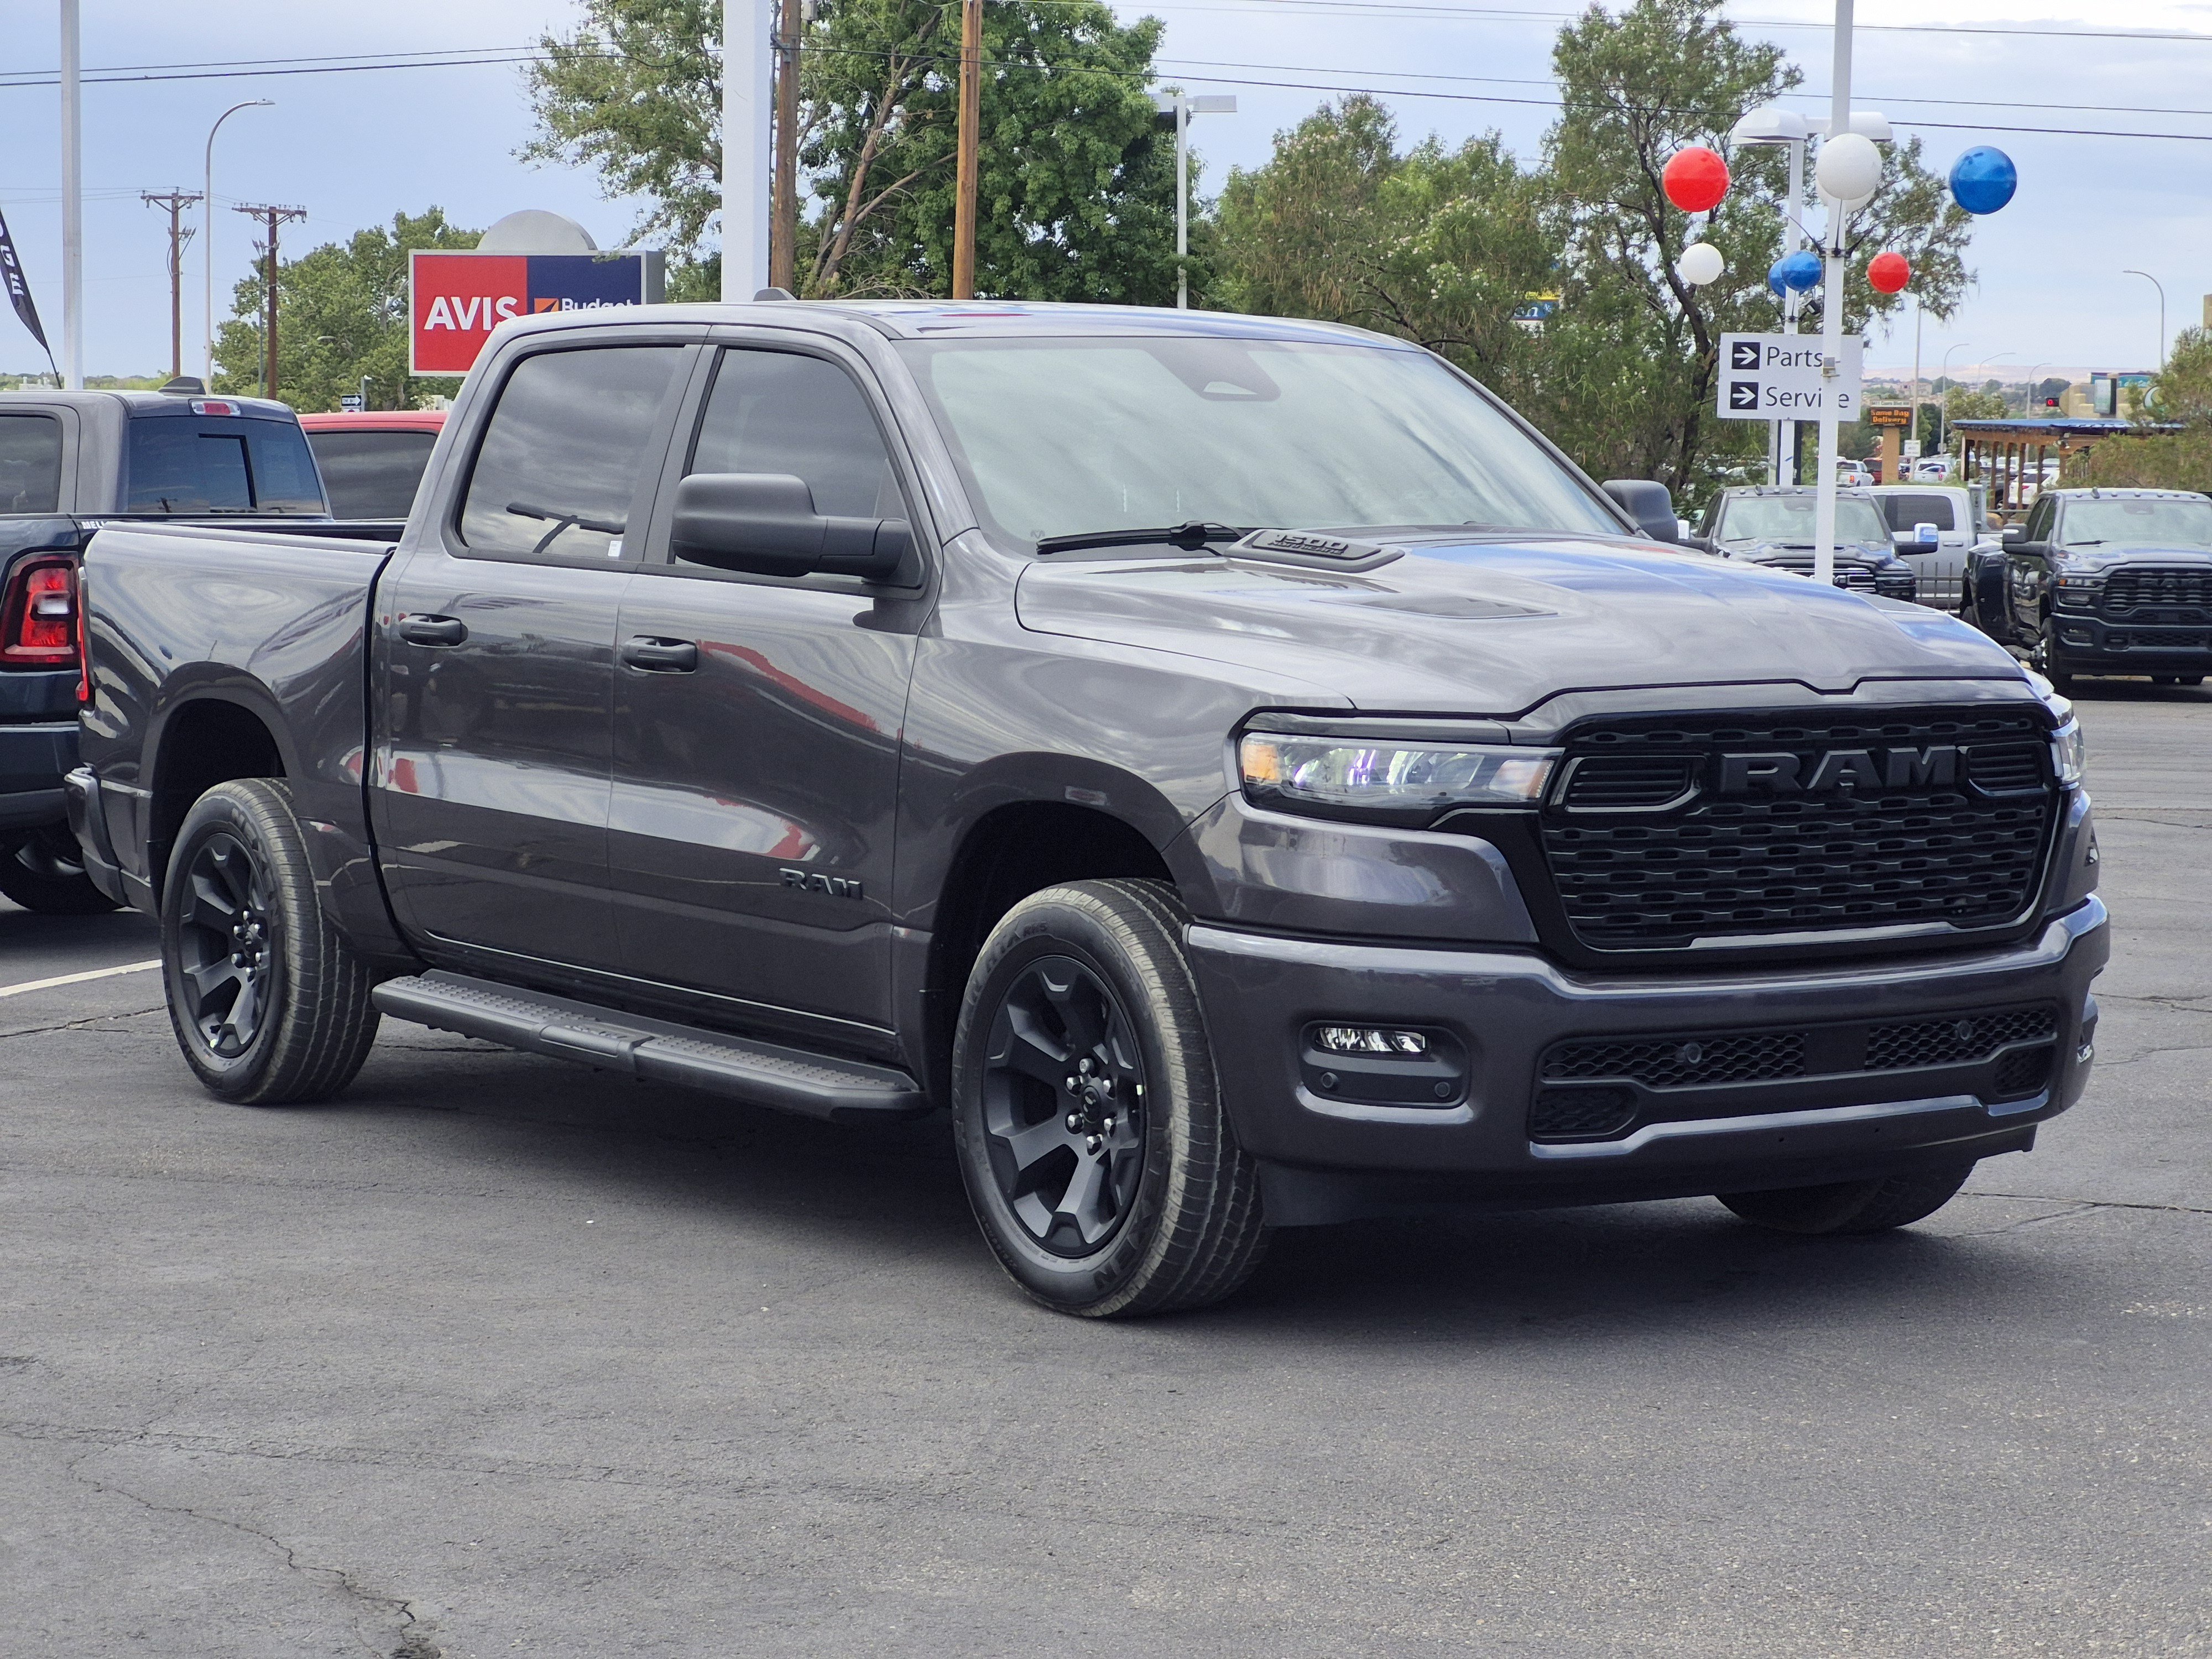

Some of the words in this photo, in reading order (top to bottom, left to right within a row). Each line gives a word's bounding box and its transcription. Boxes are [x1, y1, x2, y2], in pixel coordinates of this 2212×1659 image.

[424, 296, 518, 330] AVIS
[1767, 346, 1823, 367] Parts
[1766, 387, 1849, 408] Servie
[1873, 416, 1907, 424] Delivery
[1275, 534, 1349, 550] 1500
[1720, 745, 1957, 792] RAM
[779, 867, 863, 900] RAM
